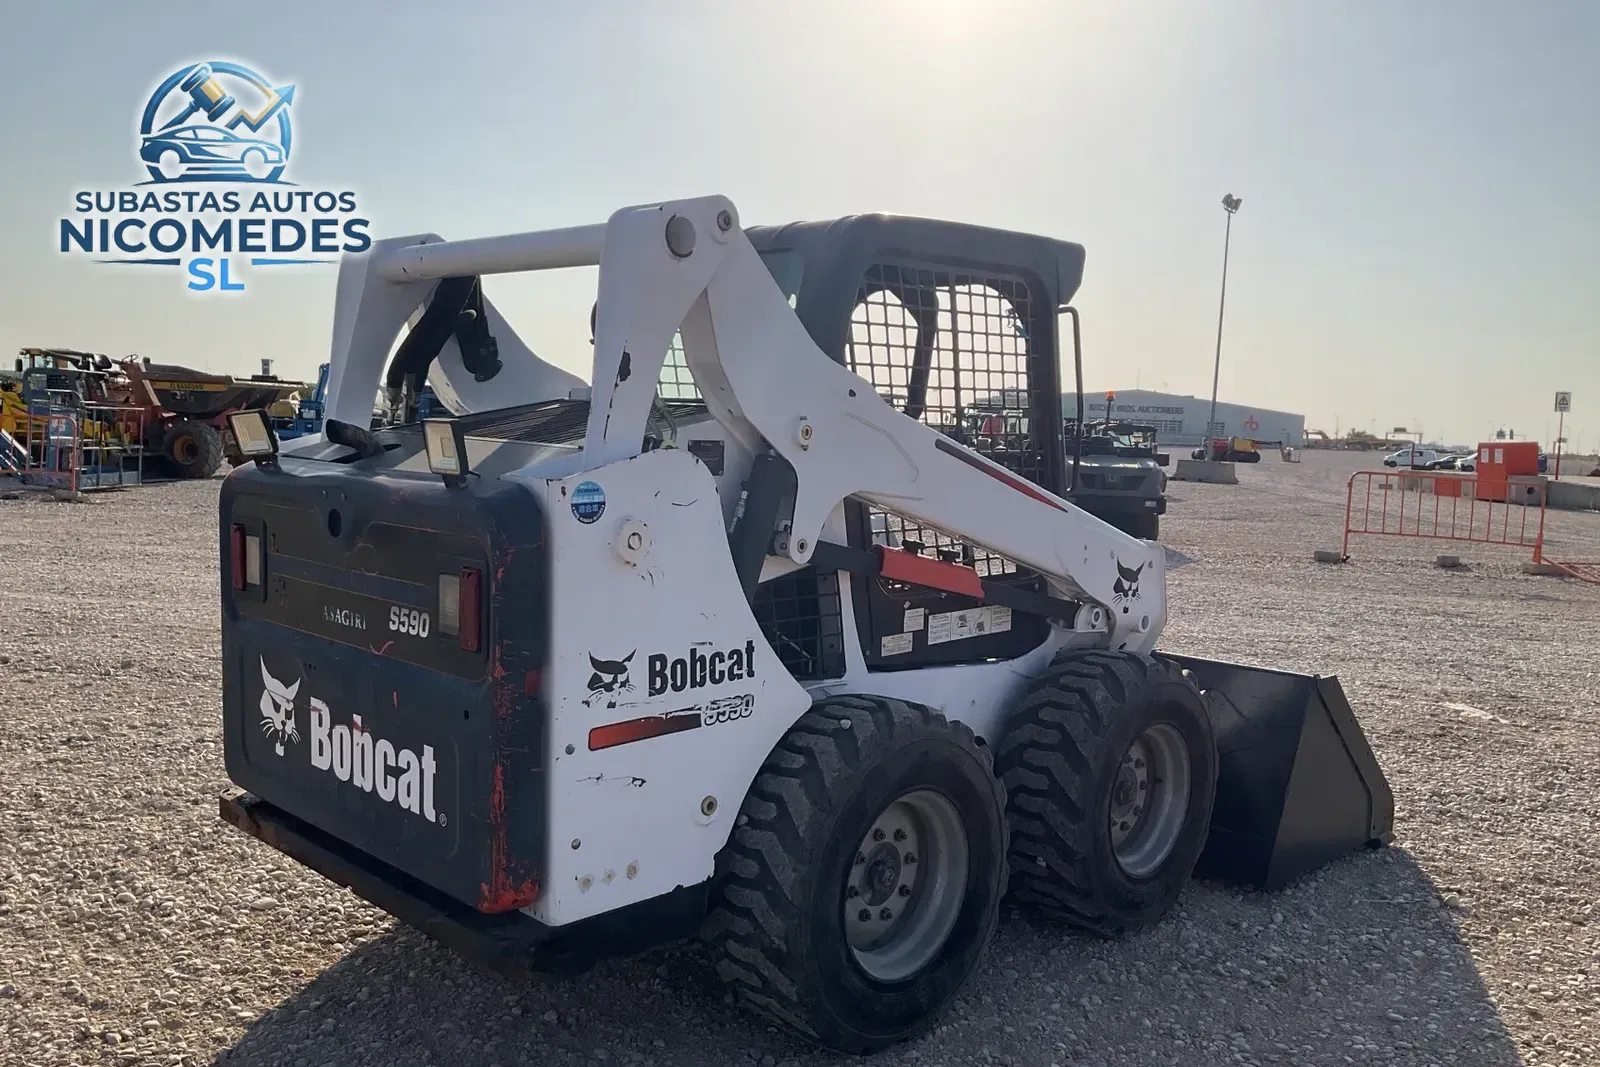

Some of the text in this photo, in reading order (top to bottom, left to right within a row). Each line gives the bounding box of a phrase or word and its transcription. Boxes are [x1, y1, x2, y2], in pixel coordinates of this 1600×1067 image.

[1136, 406, 1184, 415] AUCTIONEERS
[323, 605, 430, 638] ASAGIRI S590
[648, 640, 756, 697] Bobcat
[309, 696, 438, 823] Bobcat
